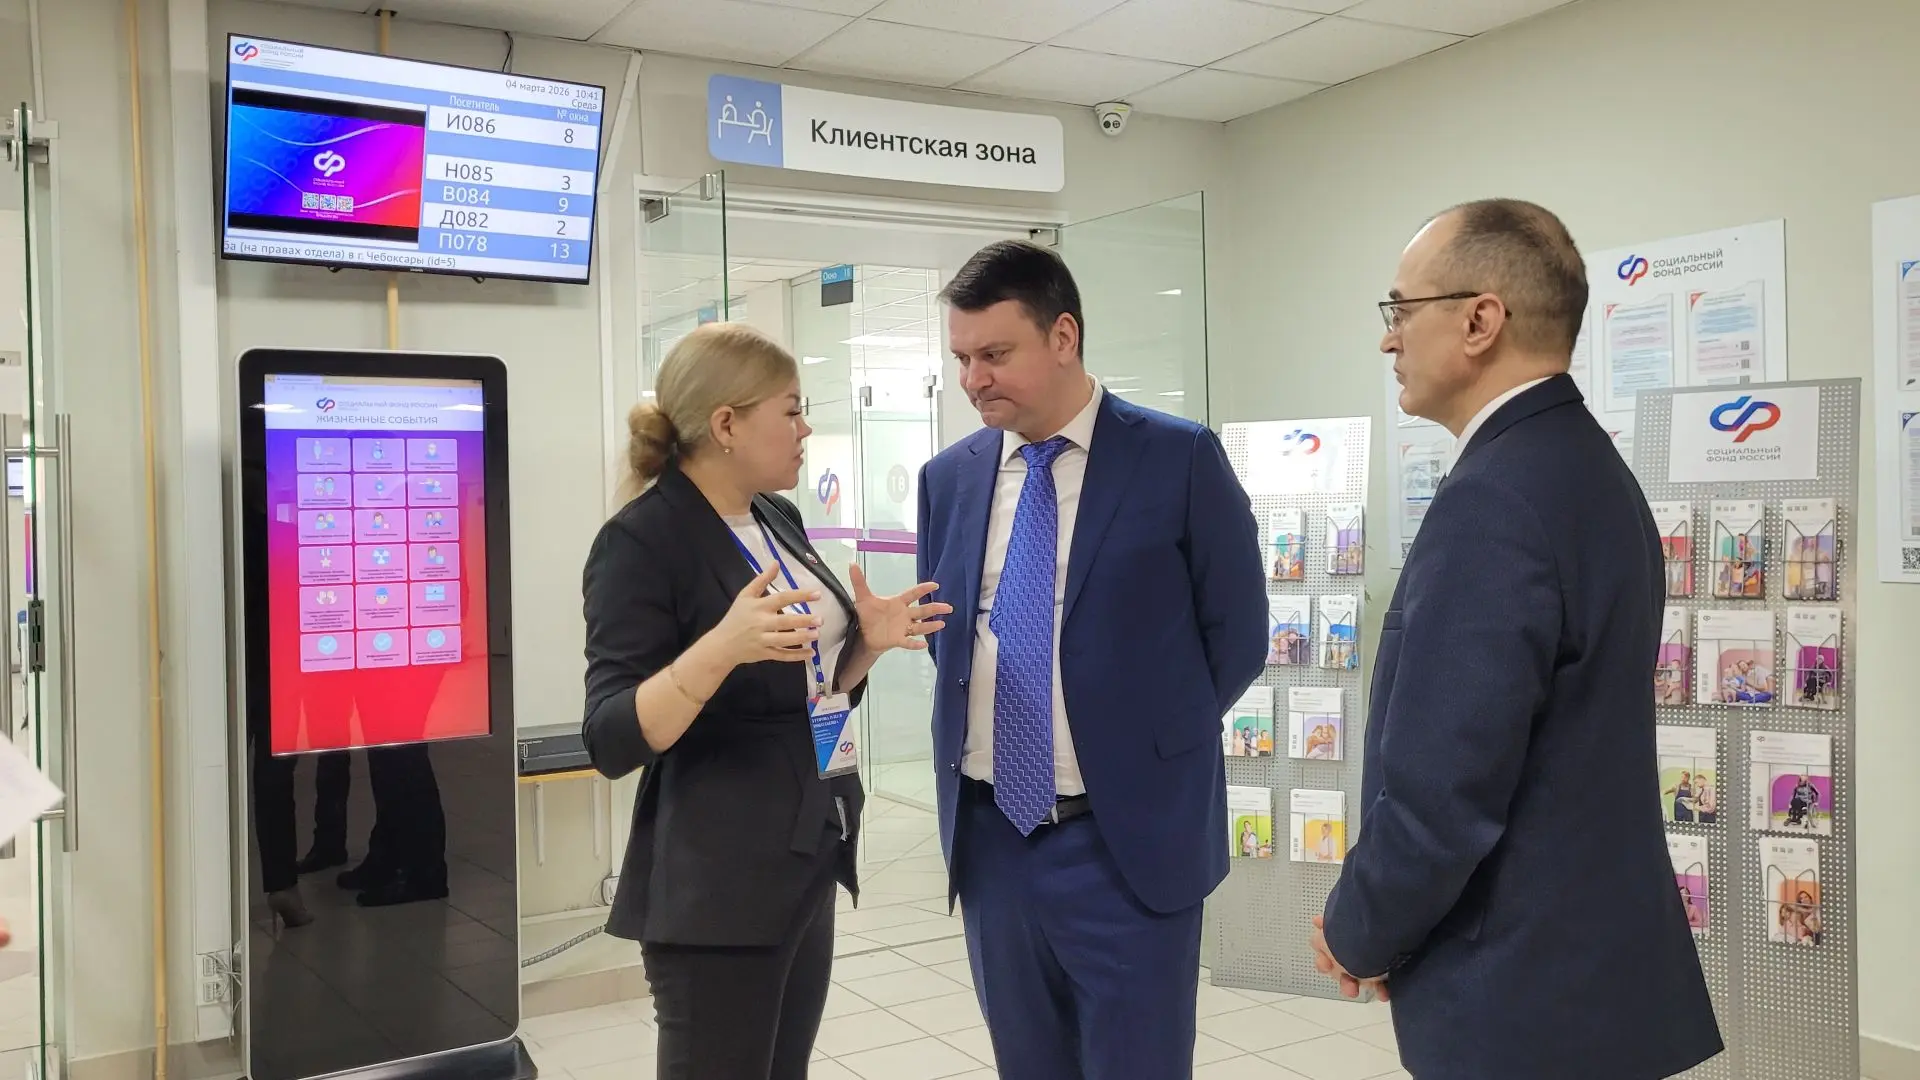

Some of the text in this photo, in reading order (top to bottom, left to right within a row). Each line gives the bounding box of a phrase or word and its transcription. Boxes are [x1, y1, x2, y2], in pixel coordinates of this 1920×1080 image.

[505, 79, 599, 100] 04 марта 2026 10:41
[449, 95, 589, 122] Посетитель № окна
[571, 98, 598, 110] Среда
[446, 112, 574, 144] И086 8
[810, 118, 1037, 165] Клиентская зона
[445, 162, 571, 191] Н085 3
[442, 185, 569, 212] В084 9
[439, 209, 566, 235] Д082 2
[240, 241, 257, 253] (на
[261, 245, 301, 257] правах
[304, 247, 345, 260] отдела)
[366, 251, 425, 267] Чебоксары
[427, 256, 456, 268] (id=5)
[438, 232, 570, 259] П078 13
[1652, 247, 1724, 269] СОЦИАЛЬНЫЙ
[1652, 260, 1724, 279] ФОНД РОССИИ
[316, 415, 438, 425] ЖИЗНЕННЫЕ СОБЫТИЯ
[1706, 445, 1781, 455] СОЦИАЛЬНЫЙ
[1706, 454, 1781, 463] ФОНД РОССИИ
[891, 474, 906, 494] 18
